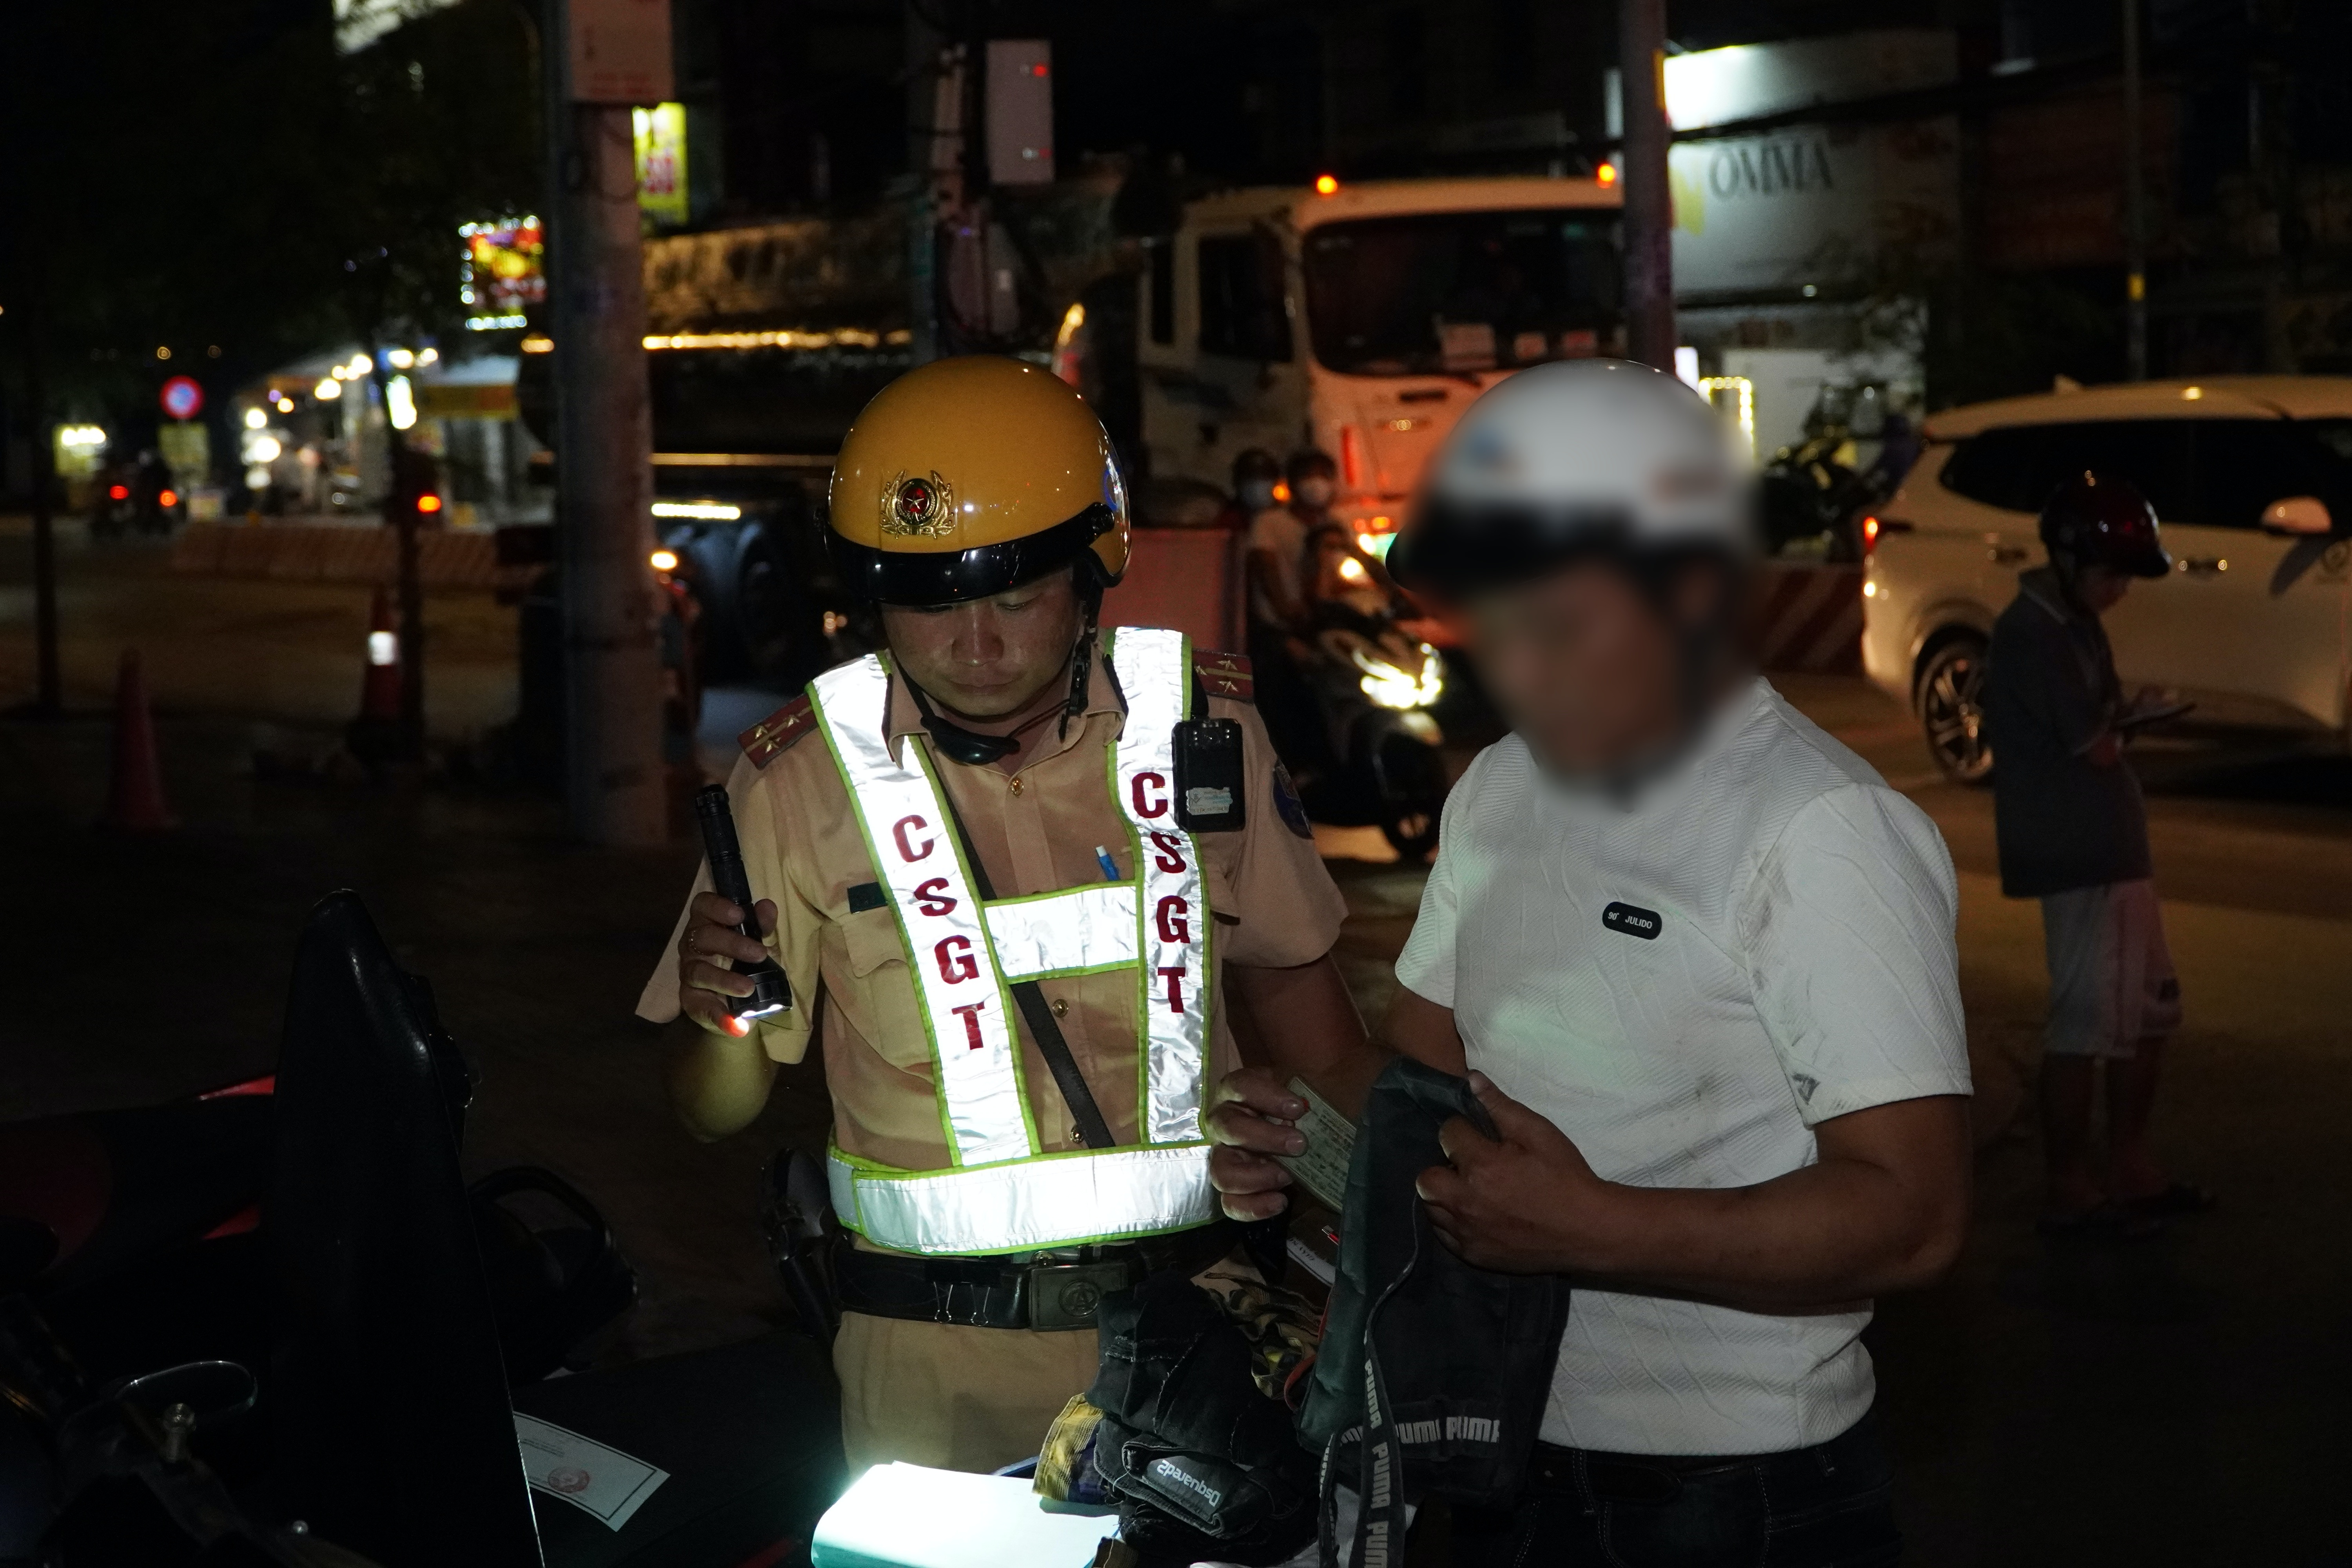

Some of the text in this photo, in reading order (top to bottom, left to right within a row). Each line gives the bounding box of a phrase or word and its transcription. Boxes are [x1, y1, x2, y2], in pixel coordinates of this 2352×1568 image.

[1132, 772, 1190, 1014] CSGT
[1625, 915, 1653, 929] JULIDO
[892, 815, 985, 1050] CSGT
[1365, 1358, 1383, 1430] PUMA
[1157, 1459, 1221, 1507] Dsquared2
[1372, 1442, 1390, 1509] PUMA
